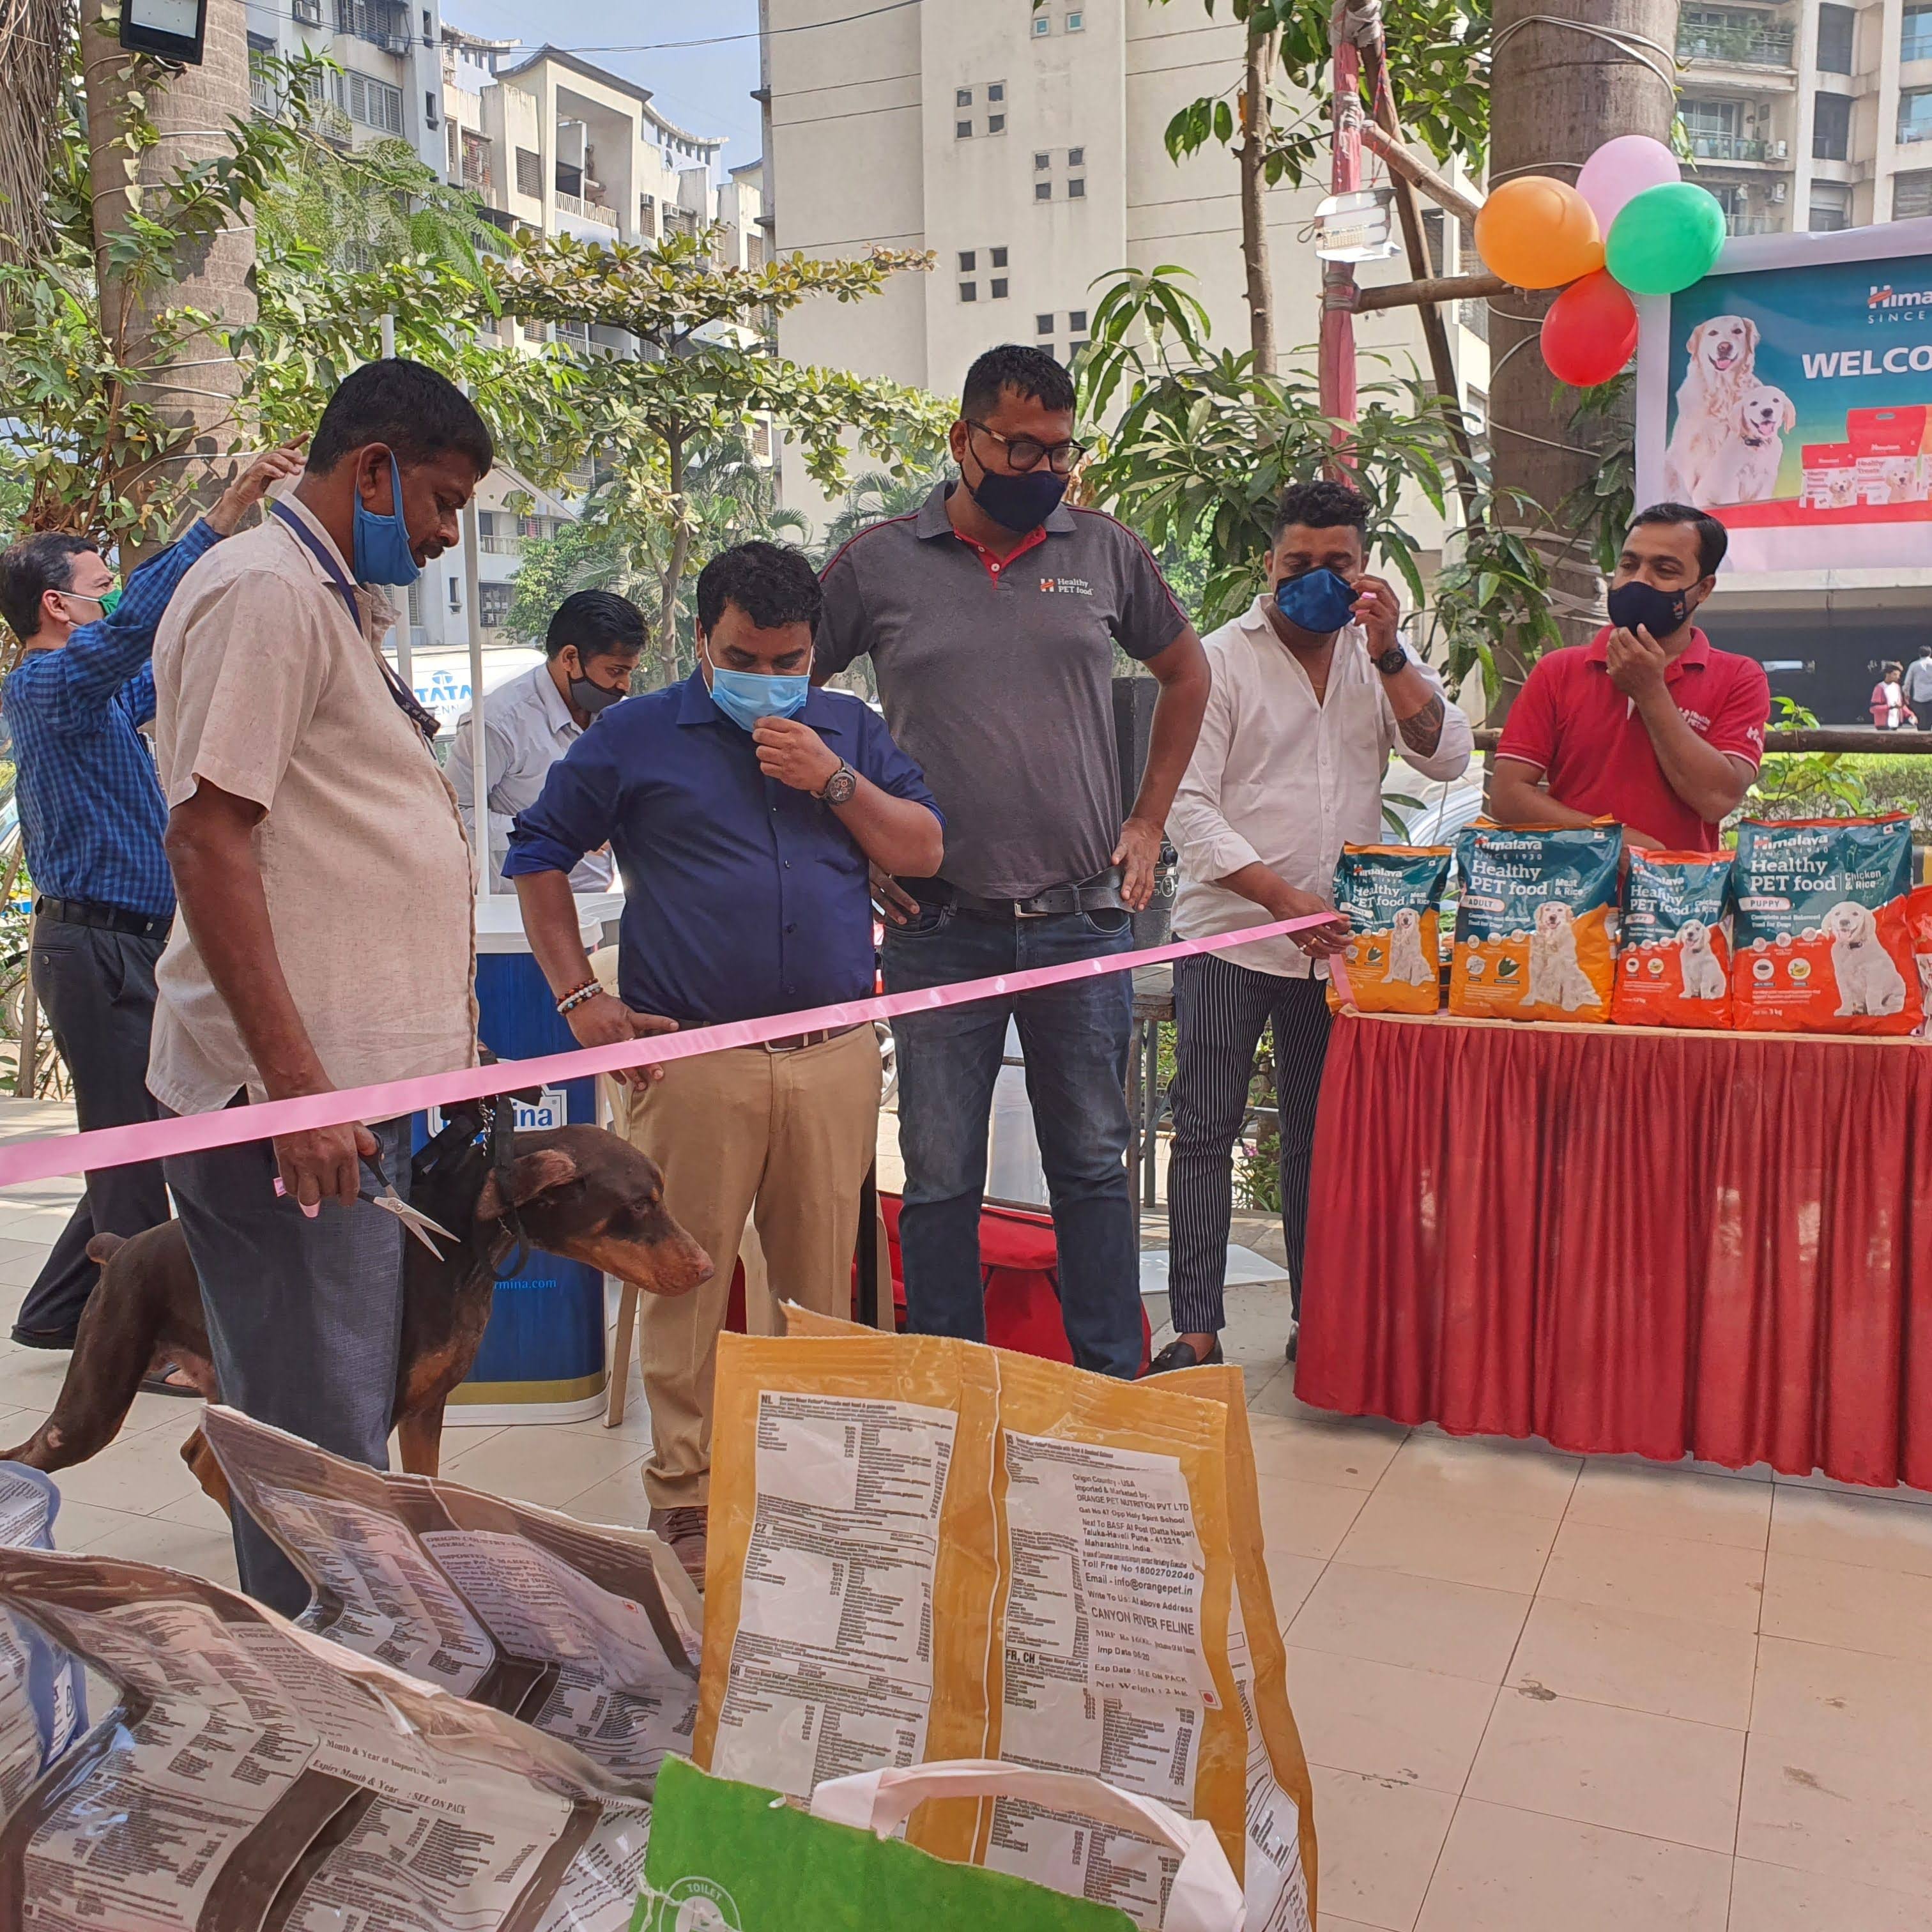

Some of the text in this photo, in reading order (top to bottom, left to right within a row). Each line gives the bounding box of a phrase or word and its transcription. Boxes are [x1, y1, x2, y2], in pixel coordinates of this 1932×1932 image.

[1867, 310, 1926, 324] SINCE
[1802, 346, 1932, 379] WELCO
[1057, 578, 1089, 588] Healthy
[414, 684, 472, 702] TATA
[1753, 834, 1828, 850] Himalaya
[1471, 859, 1542, 881] Healthy
[1750, 857, 1828, 875] Healthy
[1749, 874, 1837, 891] PET food
[1844, 870, 1882, 881] Chicken
[1353, 883, 1401, 897] Healthy
[1469, 875, 1548, 895] PET food
[1565, 887, 1584, 896] Rice
[1845, 880, 1876, 891] & Rice
[1351, 894, 1405, 908] PET food
[1468, 898, 1494, 907] ADULT
[1630, 885, 1684, 907] Healthy
[1630, 899, 1689, 916] PET food
[514, 1102, 553, 1127] ina
[494, 1278, 556, 1289] rmina.com
[761, 1395, 773, 1404] NL
[1073, 1474, 1091, 1483] Origin
[1092, 1476, 1116, 1487] Country
[1075, 1484, 1102, 1494] Imported
[1077, 1494, 1105, 1504] ORANGE
[1106, 1497, 1119, 1505] PET
[1120, 1499, 1156, 1510] NUTRITION
[1111, 1510, 1126, 1519] Opp
[1126, 1512, 1141, 1521] Holy
[1160, 1515, 1185, 1524] School
[754, 1522, 767, 1534] CZ
[1107, 1520, 1124, 1529] BASF
[1131, 1532, 1149, 1542] Pune
[1082, 1559, 1098, 1568] Toll
[1100, 1561, 1118, 1570] Free
[1121, 1563, 1133, 1573] No
[1135, 1566, 1195, 1581] 18002702040
[1085, 1572, 1107, 1584] Email
[1114, 1576, 1193, 1595] info@orangepet.in
[1087, 1590, 1105, 1600] Write
[1107, 1593, 1116, 1601] To
[1140, 1598, 1160, 1609] above
[1163, 1602, 1193, 1613] Address
[1091, 1607, 1195, 1636] CANYON RIVER FELINE
[1096, 1629, 1116, 1638] MRP
[1023, 1652, 1035, 1664] CH
[1098, 1646, 1113, 1656] Imp
[1115, 1647, 1131, 1657] Date
[1094, 1664, 1110, 1673] Exp
[1112, 1666, 1131, 1674] Date
[1165, 1674, 1188, 1683] PACK
[1096, 1680, 1114, 1689] Net
[1119, 1682, 1155, 1694] Weight
[326, 1740, 350, 1753] Month
[352, 1747, 359, 1756] &
[362, 1749, 380, 1762] Year
[312, 1759, 338, 1774] Expiry
[341, 1768, 367, 1783] Month
[367, 1777, 376, 1786] &
[378, 1779, 399, 1794] Year
[413, 1792, 431, 1804] SEE
[431, 1798, 447, 1810] ON
[447, 1802, 466, 1814] PACK
[687, 1883, 722, 1901] TOILET
